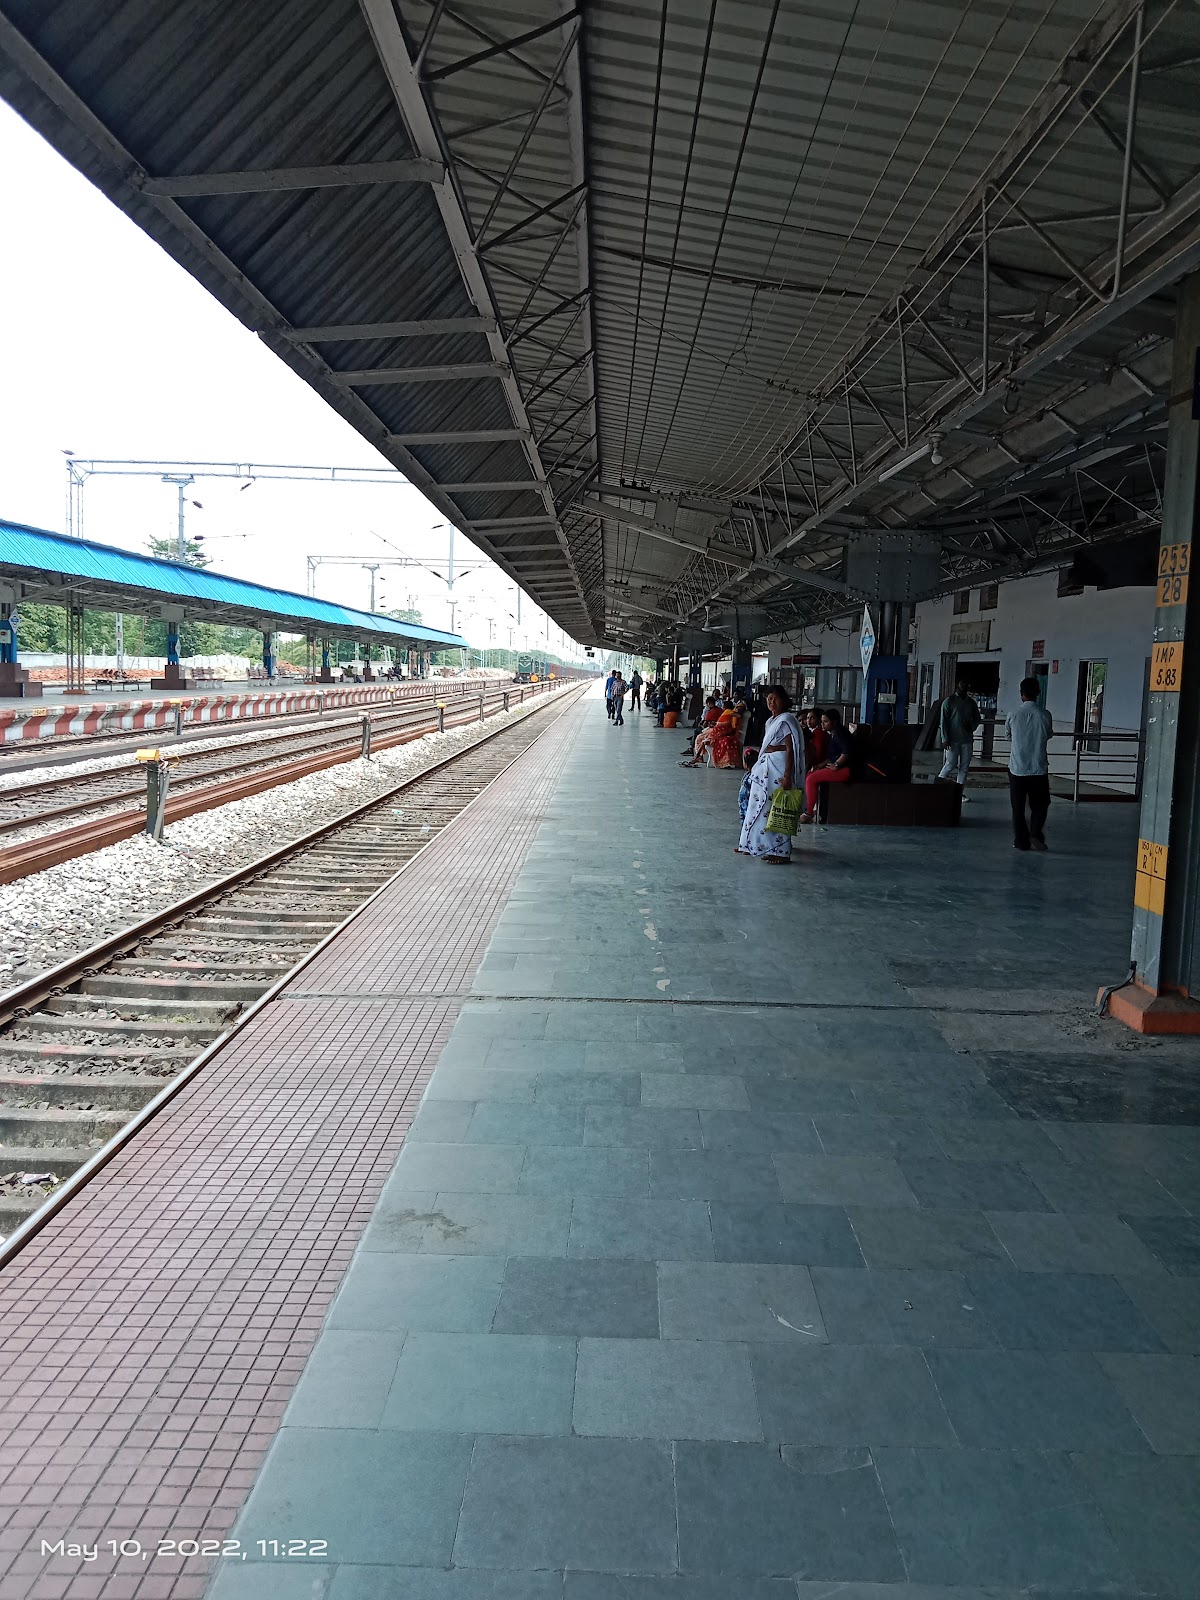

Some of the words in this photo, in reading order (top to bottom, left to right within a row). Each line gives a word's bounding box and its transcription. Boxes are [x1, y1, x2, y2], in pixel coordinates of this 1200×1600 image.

[1160, 544, 1188, 574] 253
[1162, 577, 1182, 603] 28
[1155, 646, 1174, 663] IMP
[1156, 668, 1177, 686] 5.83
